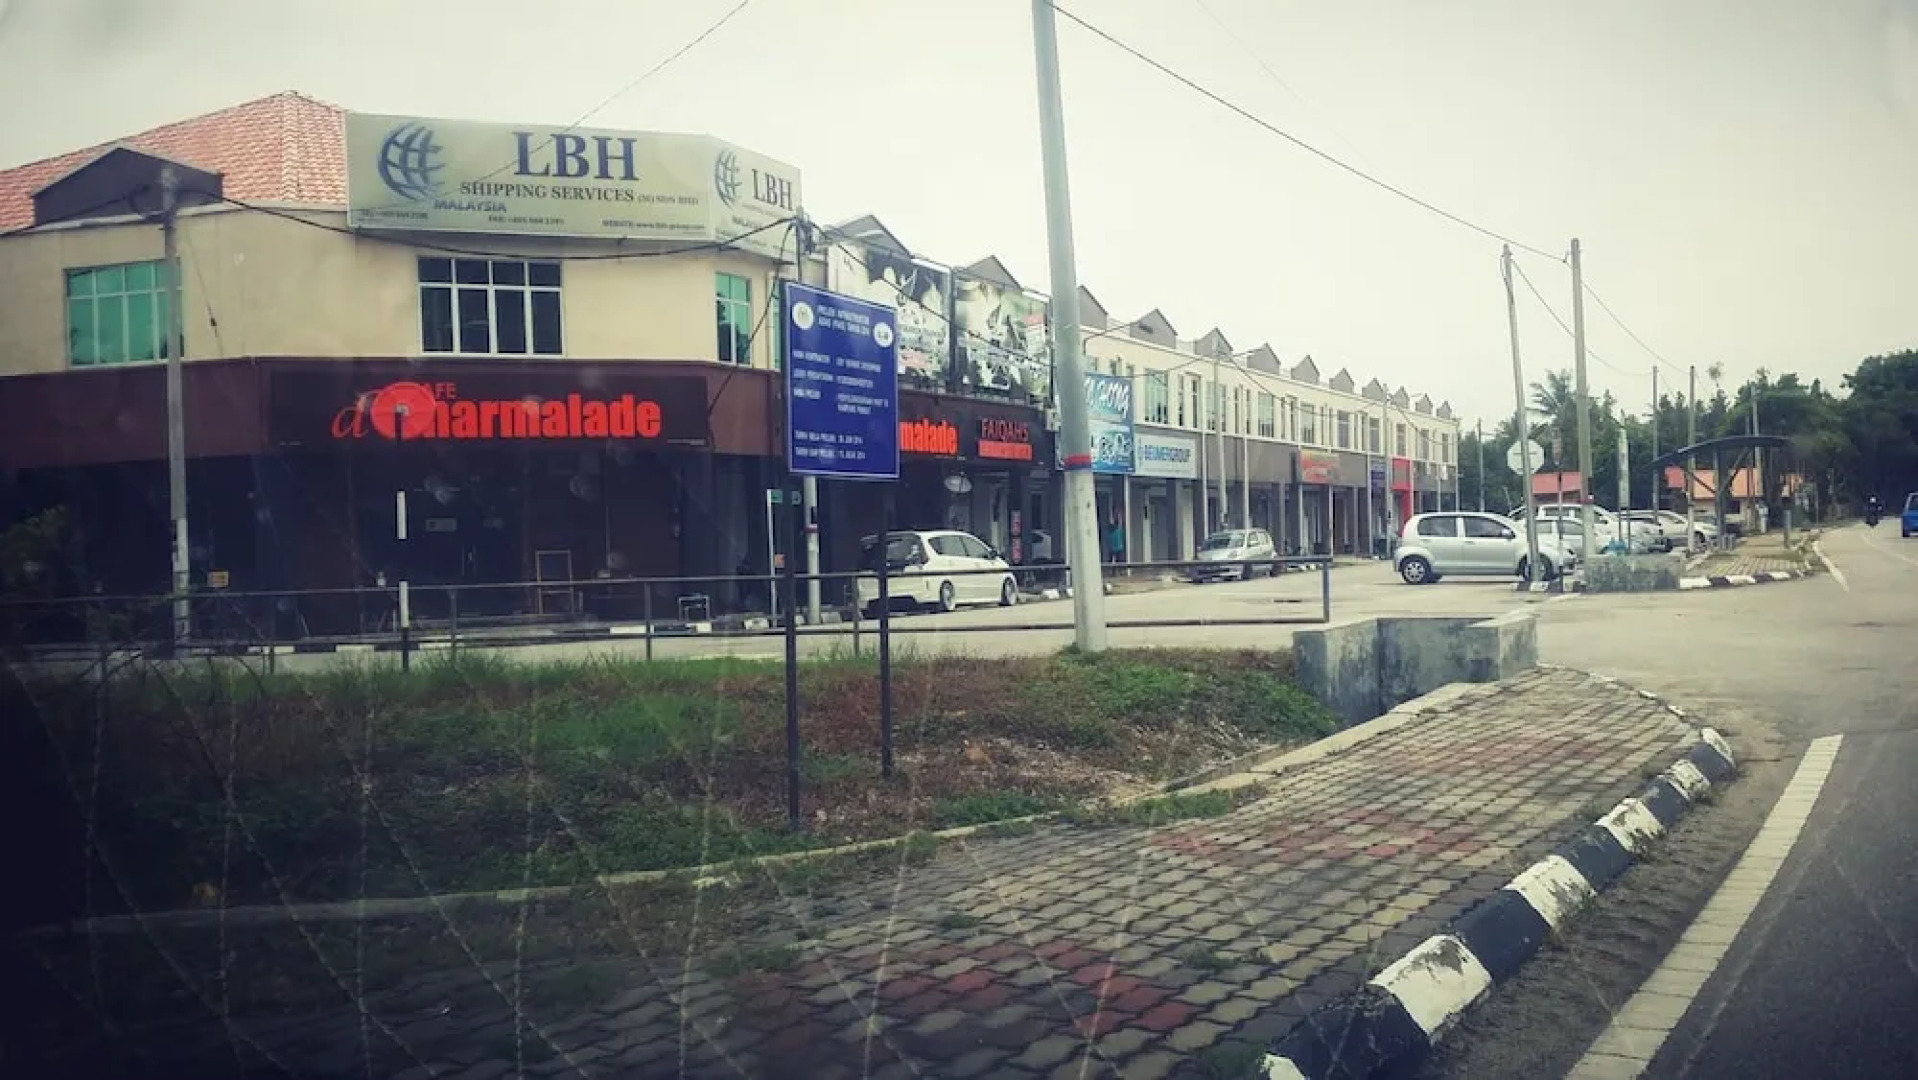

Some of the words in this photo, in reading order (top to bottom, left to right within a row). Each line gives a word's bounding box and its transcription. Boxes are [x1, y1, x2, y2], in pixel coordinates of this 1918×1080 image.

[513, 132, 640, 181] LBH
[433, 200, 507, 213] MALAYSIA
[460, 182, 547, 199] SHIPPING
[552, 185, 634, 202] SERVICES
[752, 169, 793, 211] LBH
[898, 417, 958, 454] malade
